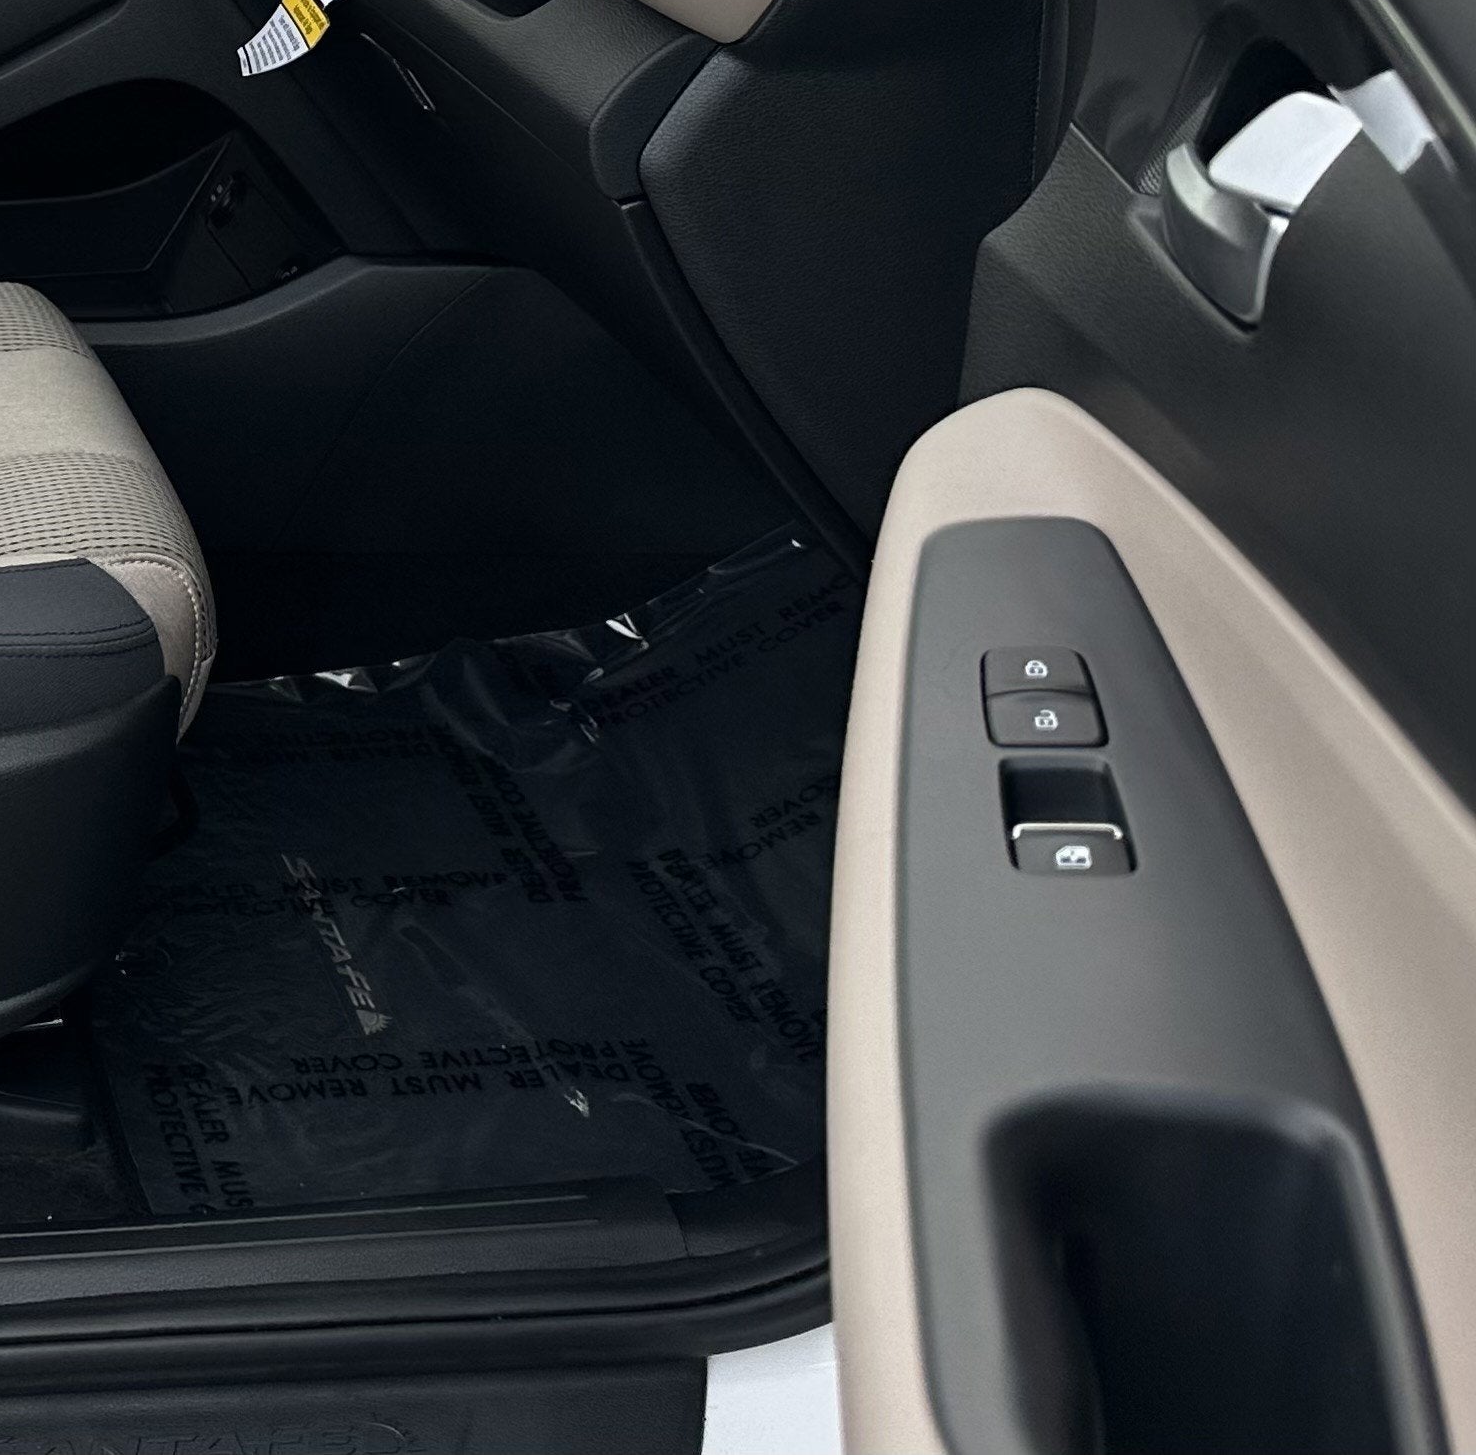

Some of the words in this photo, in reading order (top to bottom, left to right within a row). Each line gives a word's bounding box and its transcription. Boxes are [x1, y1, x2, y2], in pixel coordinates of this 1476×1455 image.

[694, 619, 767, 667] MUST
[756, 599, 845, 656] COVER
[624, 860, 713, 962] PROTECTIVE
[708, 923, 762, 973] MUST
[290, 1052, 404, 1074] COVER
[418, 1038, 616, 1070] PROTECTIVE
[224, 1076, 365, 1107] REMOVE
[391, 1069, 482, 1097] MUST
[505, 1061, 632, 1090] DEALER
[178, 1062, 230, 1145] DEALER
